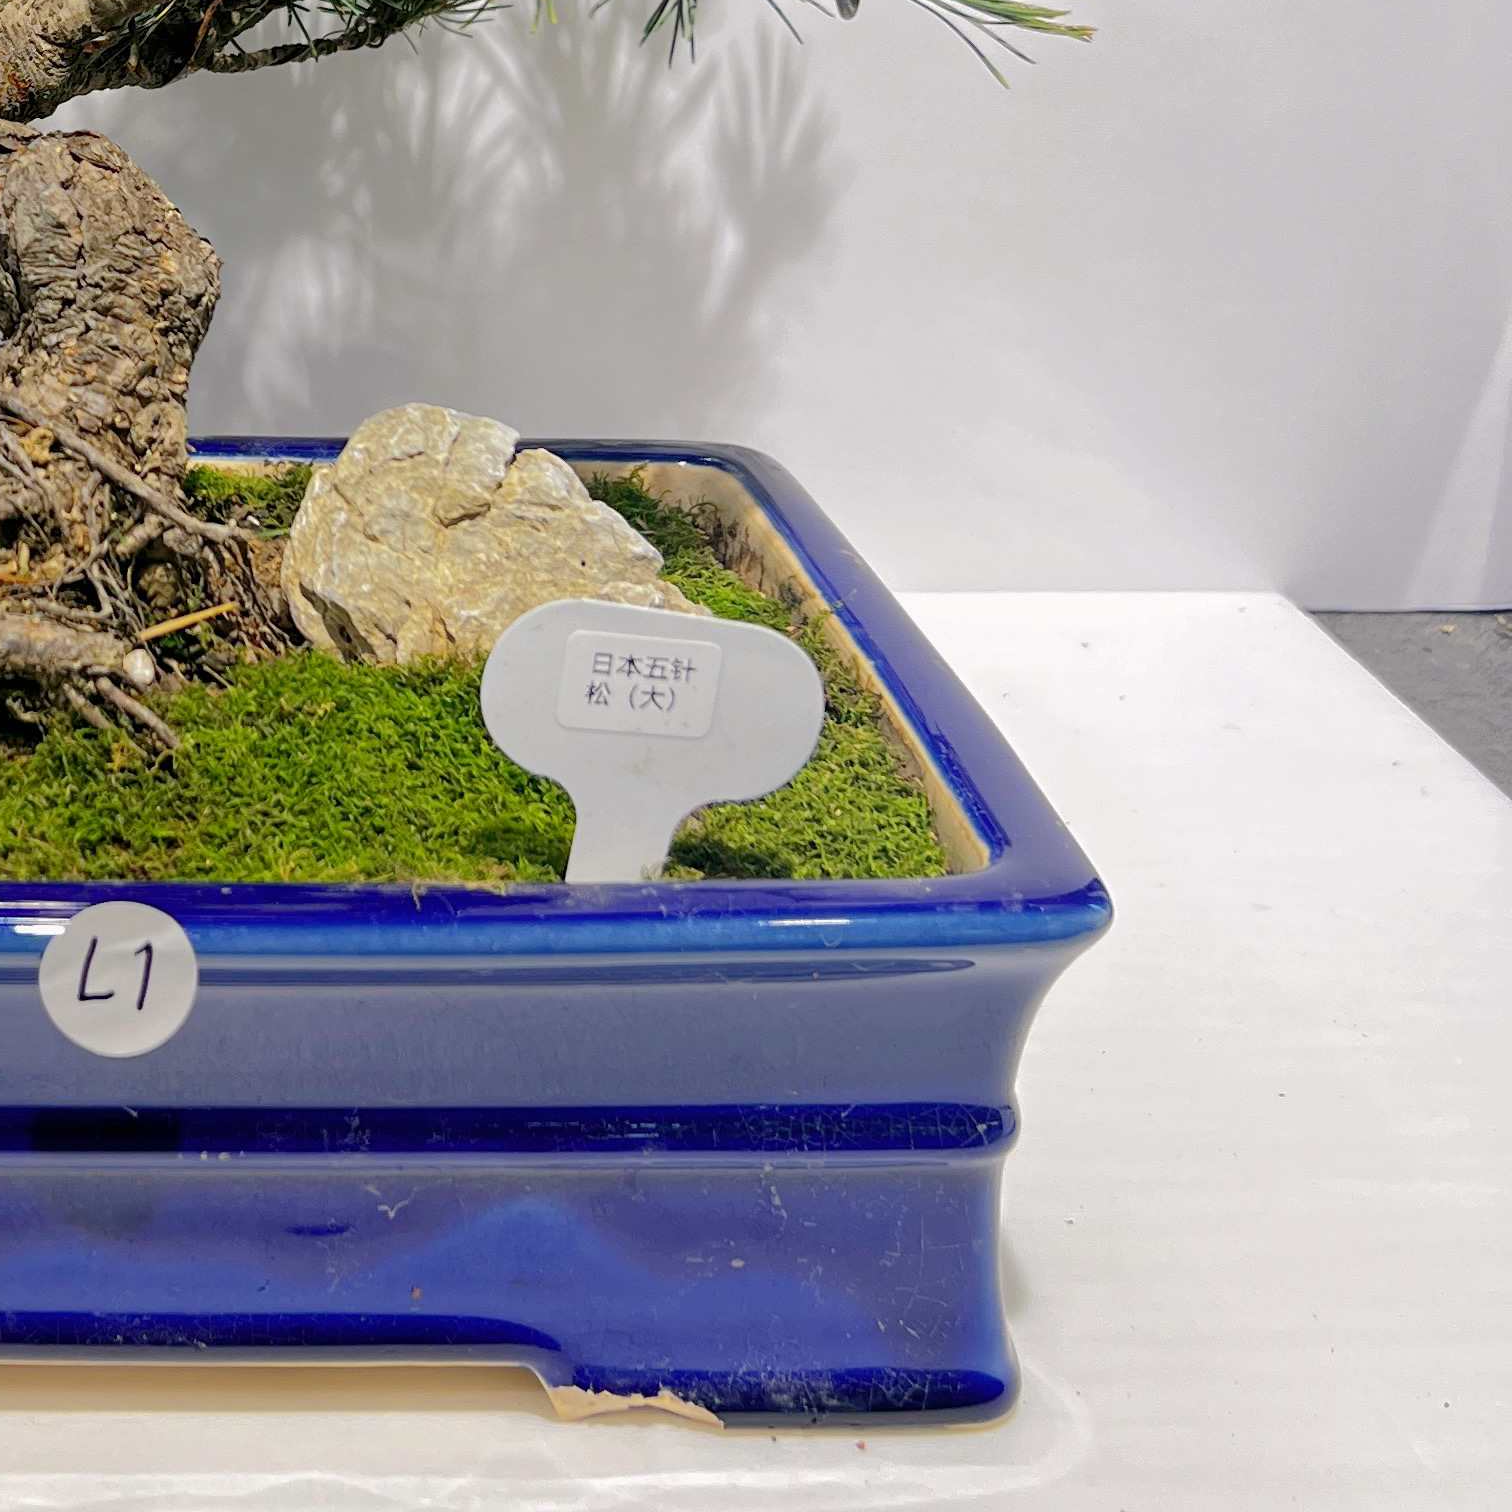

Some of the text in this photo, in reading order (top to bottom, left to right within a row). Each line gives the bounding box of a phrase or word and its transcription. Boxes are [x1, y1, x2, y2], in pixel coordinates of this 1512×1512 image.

[592, 652, 697, 682] 日本五針
[78, 937, 153, 1010] L1
